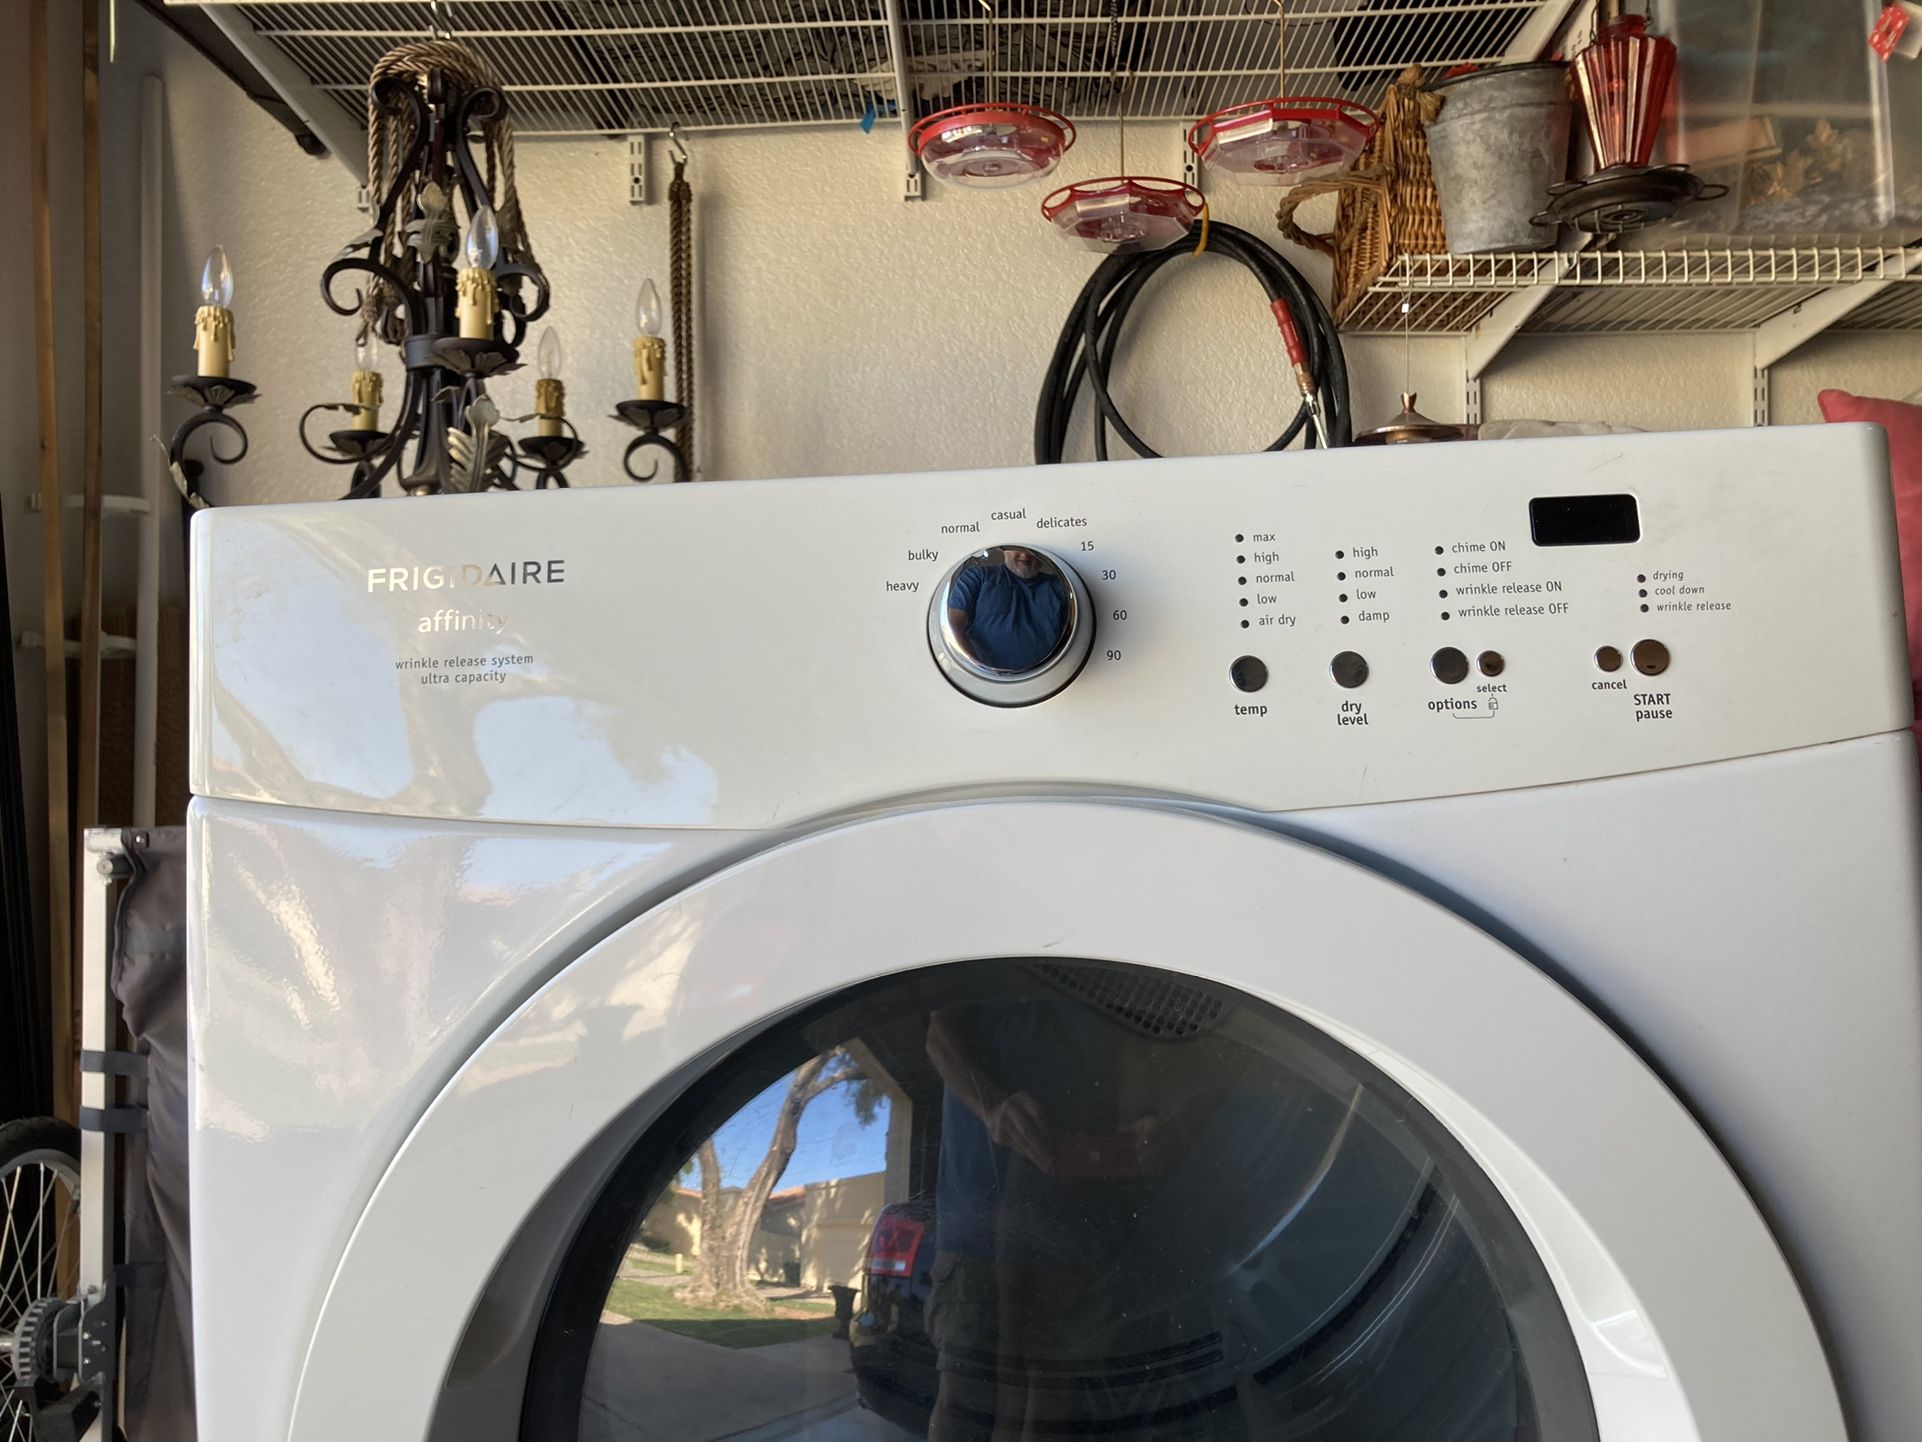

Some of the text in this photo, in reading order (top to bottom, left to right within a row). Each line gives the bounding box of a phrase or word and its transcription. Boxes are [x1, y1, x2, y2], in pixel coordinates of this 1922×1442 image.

[991, 508, 1026, 520] casual
[941, 521, 980, 534] normal
[1037, 516, 1087, 529] delicates
[1253, 533, 1276, 542] max
[1081, 540, 1094, 551] 15
[1452, 540, 1506, 553] chime ON
[908, 549, 938, 562] bulky
[1254, 551, 1279, 564] high
[1353, 546, 1378, 559] high
[1355, 566, 1394, 578] normal
[1454, 560, 1512, 574] chime OFF
[367, 559, 564, 592] FRIGIDAIRE
[1102, 569, 1116, 580] 30
[1256, 571, 1295, 583] normal
[1653, 569, 1684, 582] drying
[886, 580, 919, 593] heavy
[1456, 580, 1562, 595] wrinkle release ON
[1655, 584, 1705, 595] cool down
[1257, 593, 1277, 604] low
[1356, 588, 1376, 599] low
[1458, 602, 1569, 617] wrinkle release OFF
[1657, 600, 1731, 611] wrinkle release
[418, 608, 509, 634] affinity
[1113, 610, 1127, 620] 60
[1259, 613, 1296, 626] air dry
[1358, 610, 1390, 622] damp
[395, 653, 533, 670] wrinkle release system
[1107, 650, 1121, 660] 90
[422, 670, 507, 685] ultra capacity
[1476, 682, 1507, 693] select
[1592, 679, 1627, 690] cancel
[1428, 697, 1477, 711] options
[1633, 693, 1671, 706] START
[1234, 704, 1268, 716] temp
[1341, 700, 1362, 714] dry
[1337, 713, 1368, 725] level
[1635, 708, 1672, 721] pause
